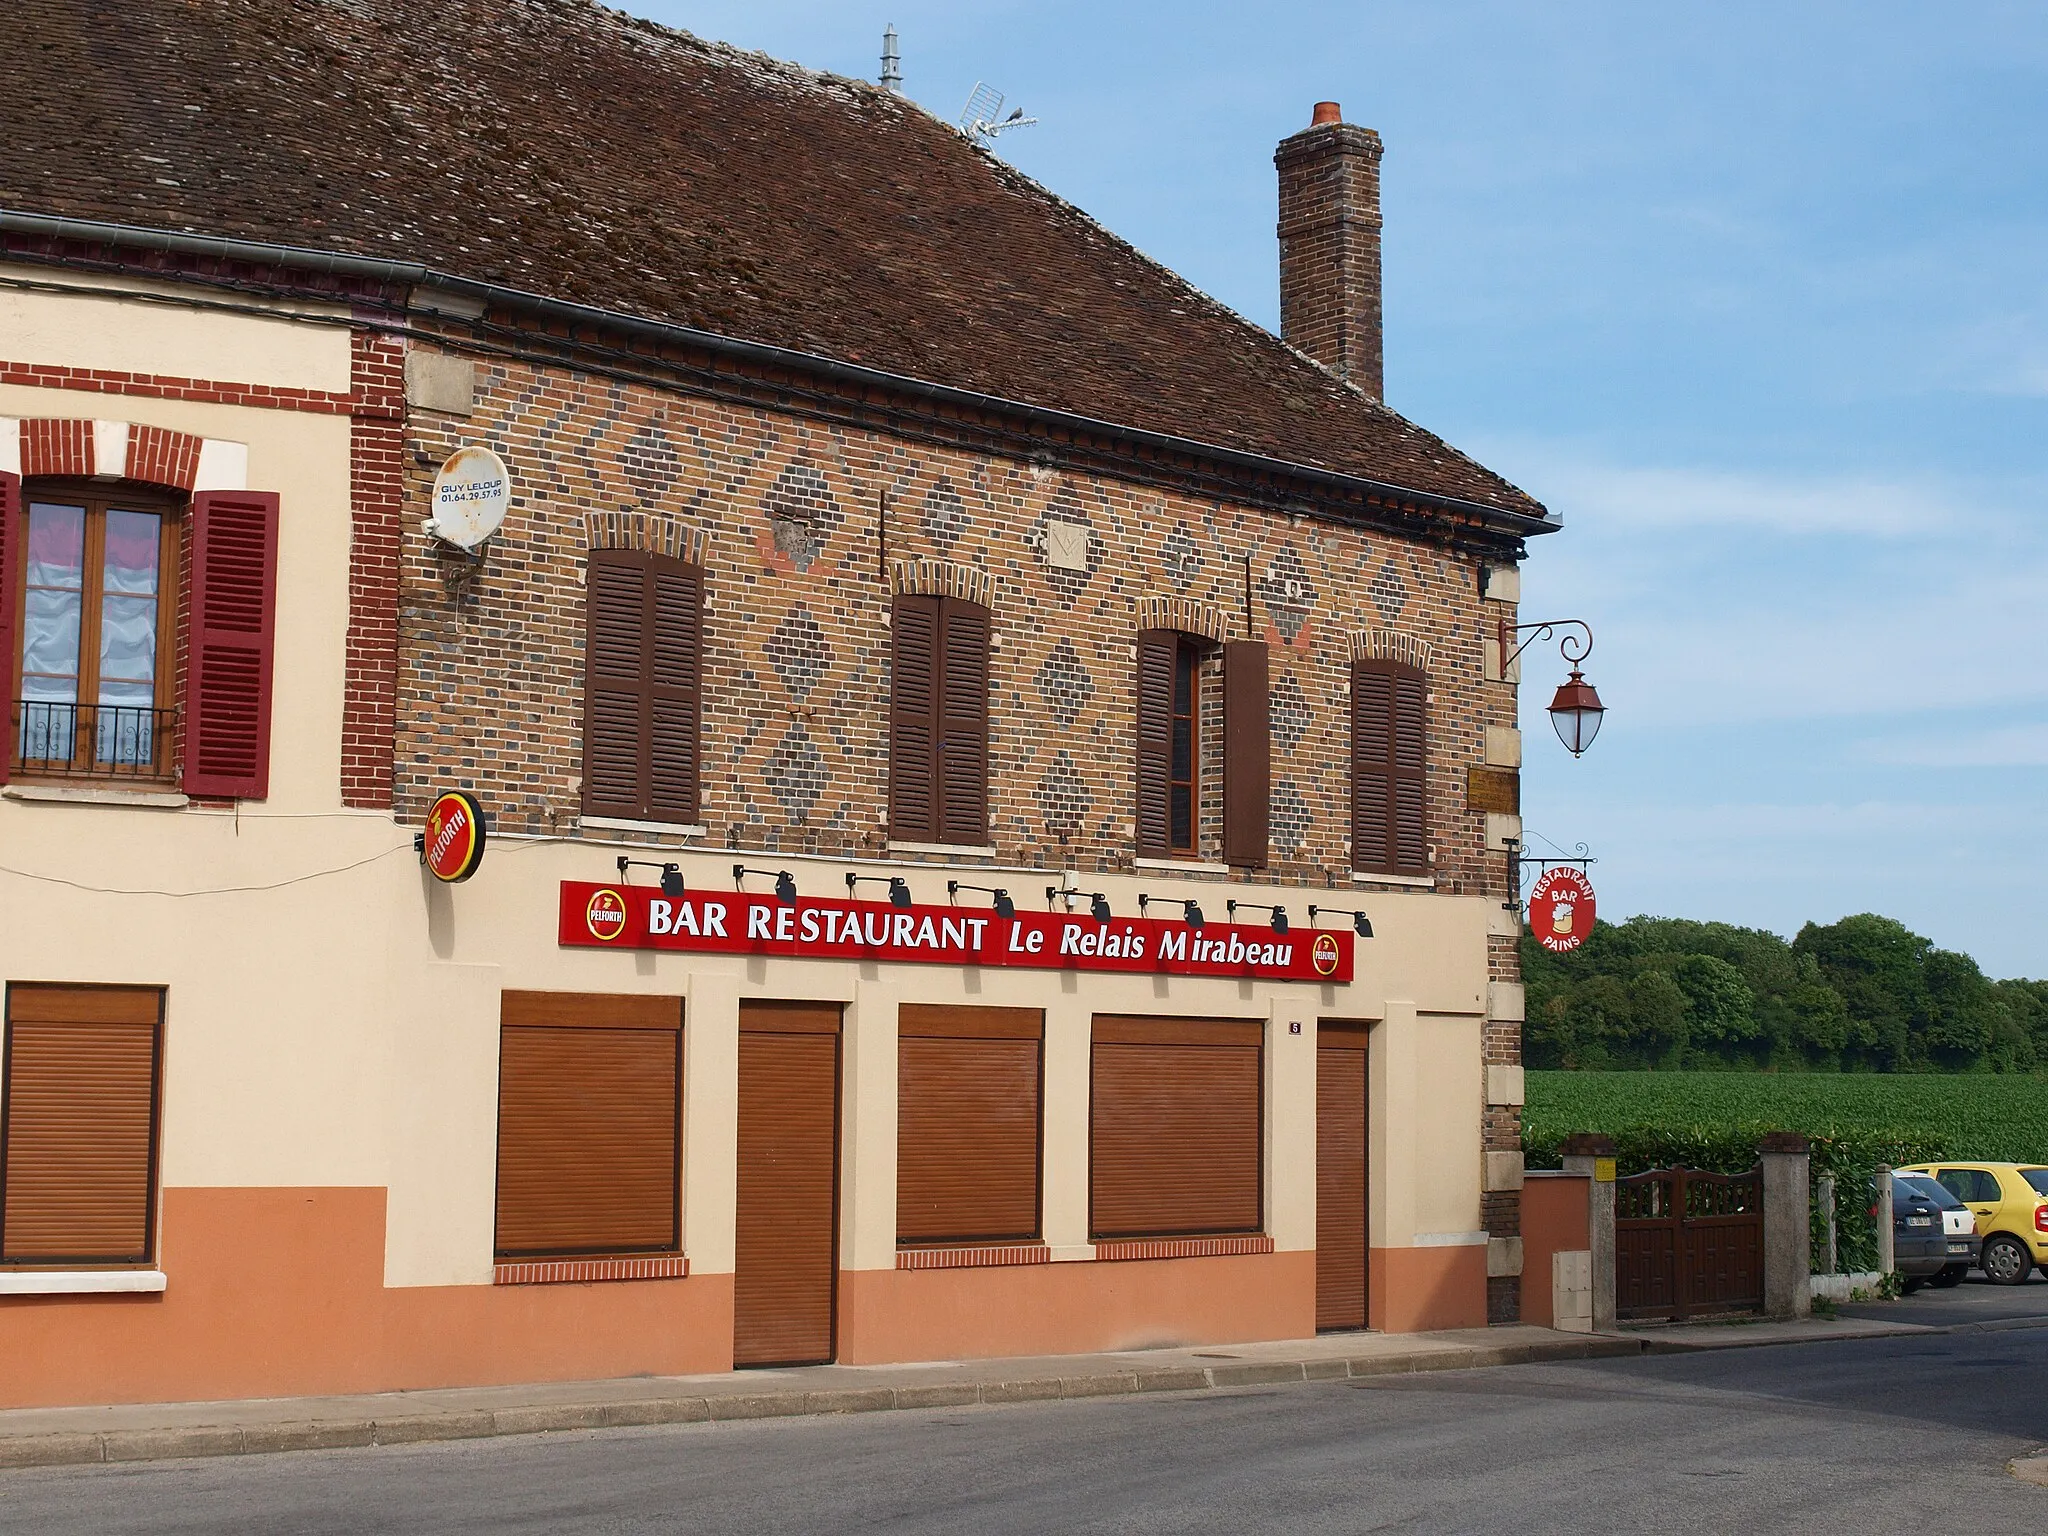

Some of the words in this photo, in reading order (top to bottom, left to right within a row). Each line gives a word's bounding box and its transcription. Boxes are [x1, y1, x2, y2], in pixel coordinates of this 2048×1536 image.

[441, 484, 464, 493] GUY
[467, 480, 502, 490] LELOUP
[441, 489, 502, 502] 01.64.29.57.95
[430, 809, 465, 869] PELFORTH
[1533, 868, 1595, 900] RESTAURANT
[1552, 889, 1578, 902] BAR
[590, 909, 622, 923] PELFORTH
[648, 899, 727, 938] BAR
[747, 904, 989, 951] RESTAURANT
[1008, 920, 1044, 953] Le
[1060, 923, 1145, 960] Relais
[1542, 936, 1580, 951] PAINS
[1292, 1023, 1299, 1033] 5
